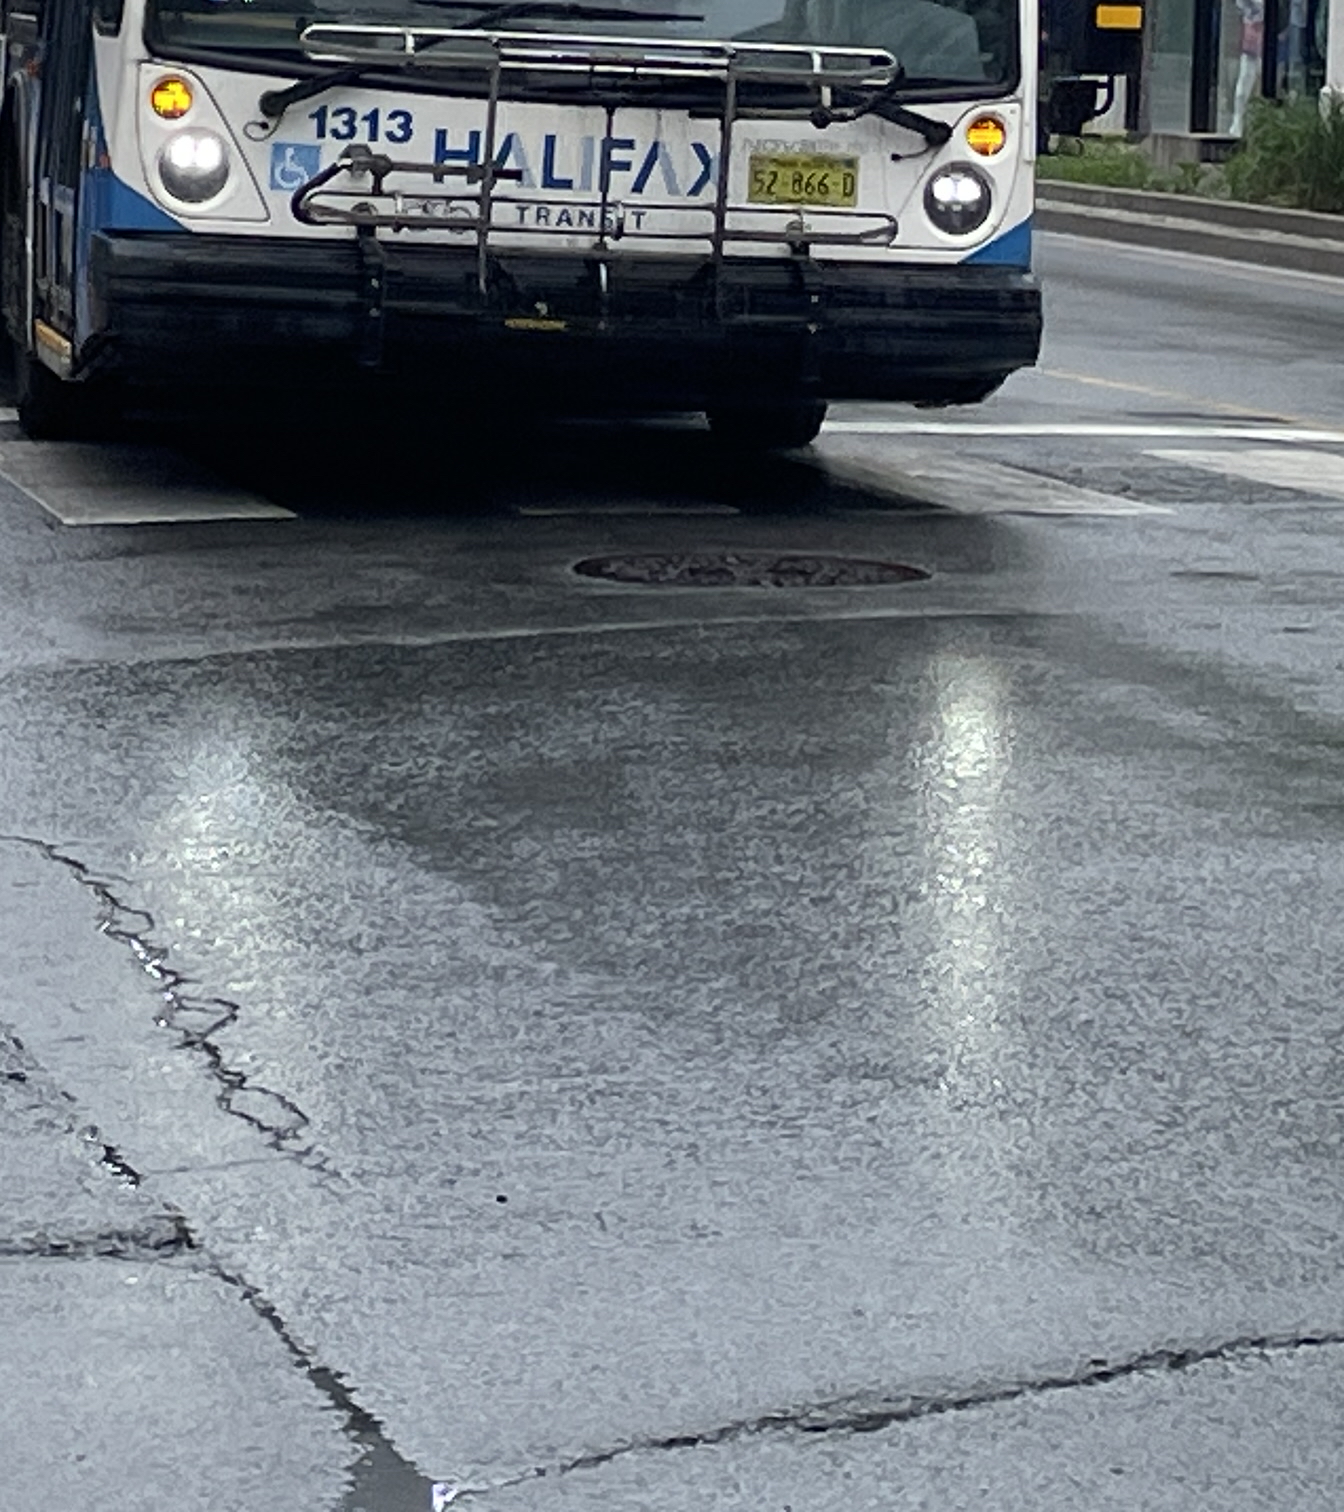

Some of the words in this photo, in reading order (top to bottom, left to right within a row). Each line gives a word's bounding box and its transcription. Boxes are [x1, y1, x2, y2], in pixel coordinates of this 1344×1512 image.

[308, 105, 413, 144] 1313
[435, 128, 724, 197] HALIFAX
[516, 205, 646, 230] TRANST
